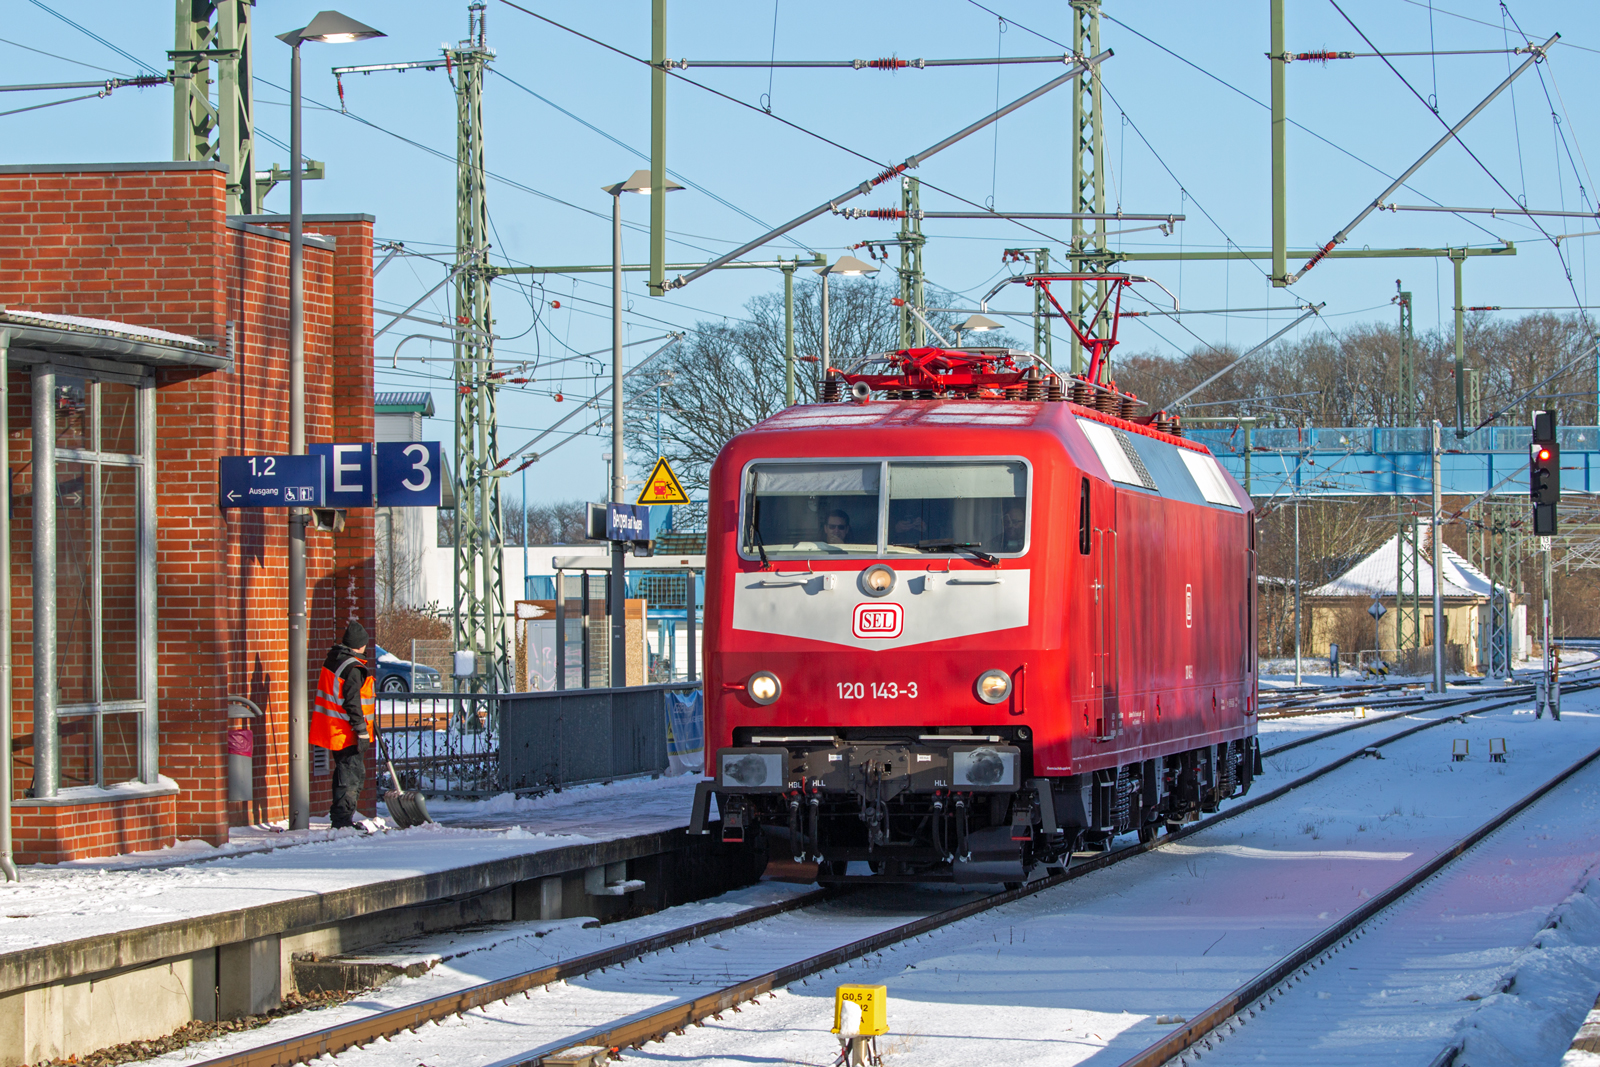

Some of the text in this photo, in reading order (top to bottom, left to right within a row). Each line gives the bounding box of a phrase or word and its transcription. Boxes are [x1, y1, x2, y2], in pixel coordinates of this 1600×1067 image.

[248, 456, 276, 477] 1,2
[333, 445, 363, 491] E
[402, 444, 431, 492] 3
[249, 487, 279, 496] Ausgang
[613, 509, 627, 533] Bergen
[863, 613, 892, 628] SEL
[837, 682, 918, 699] 120 143-3
[842, 993, 872, 1002] G0,5 2
